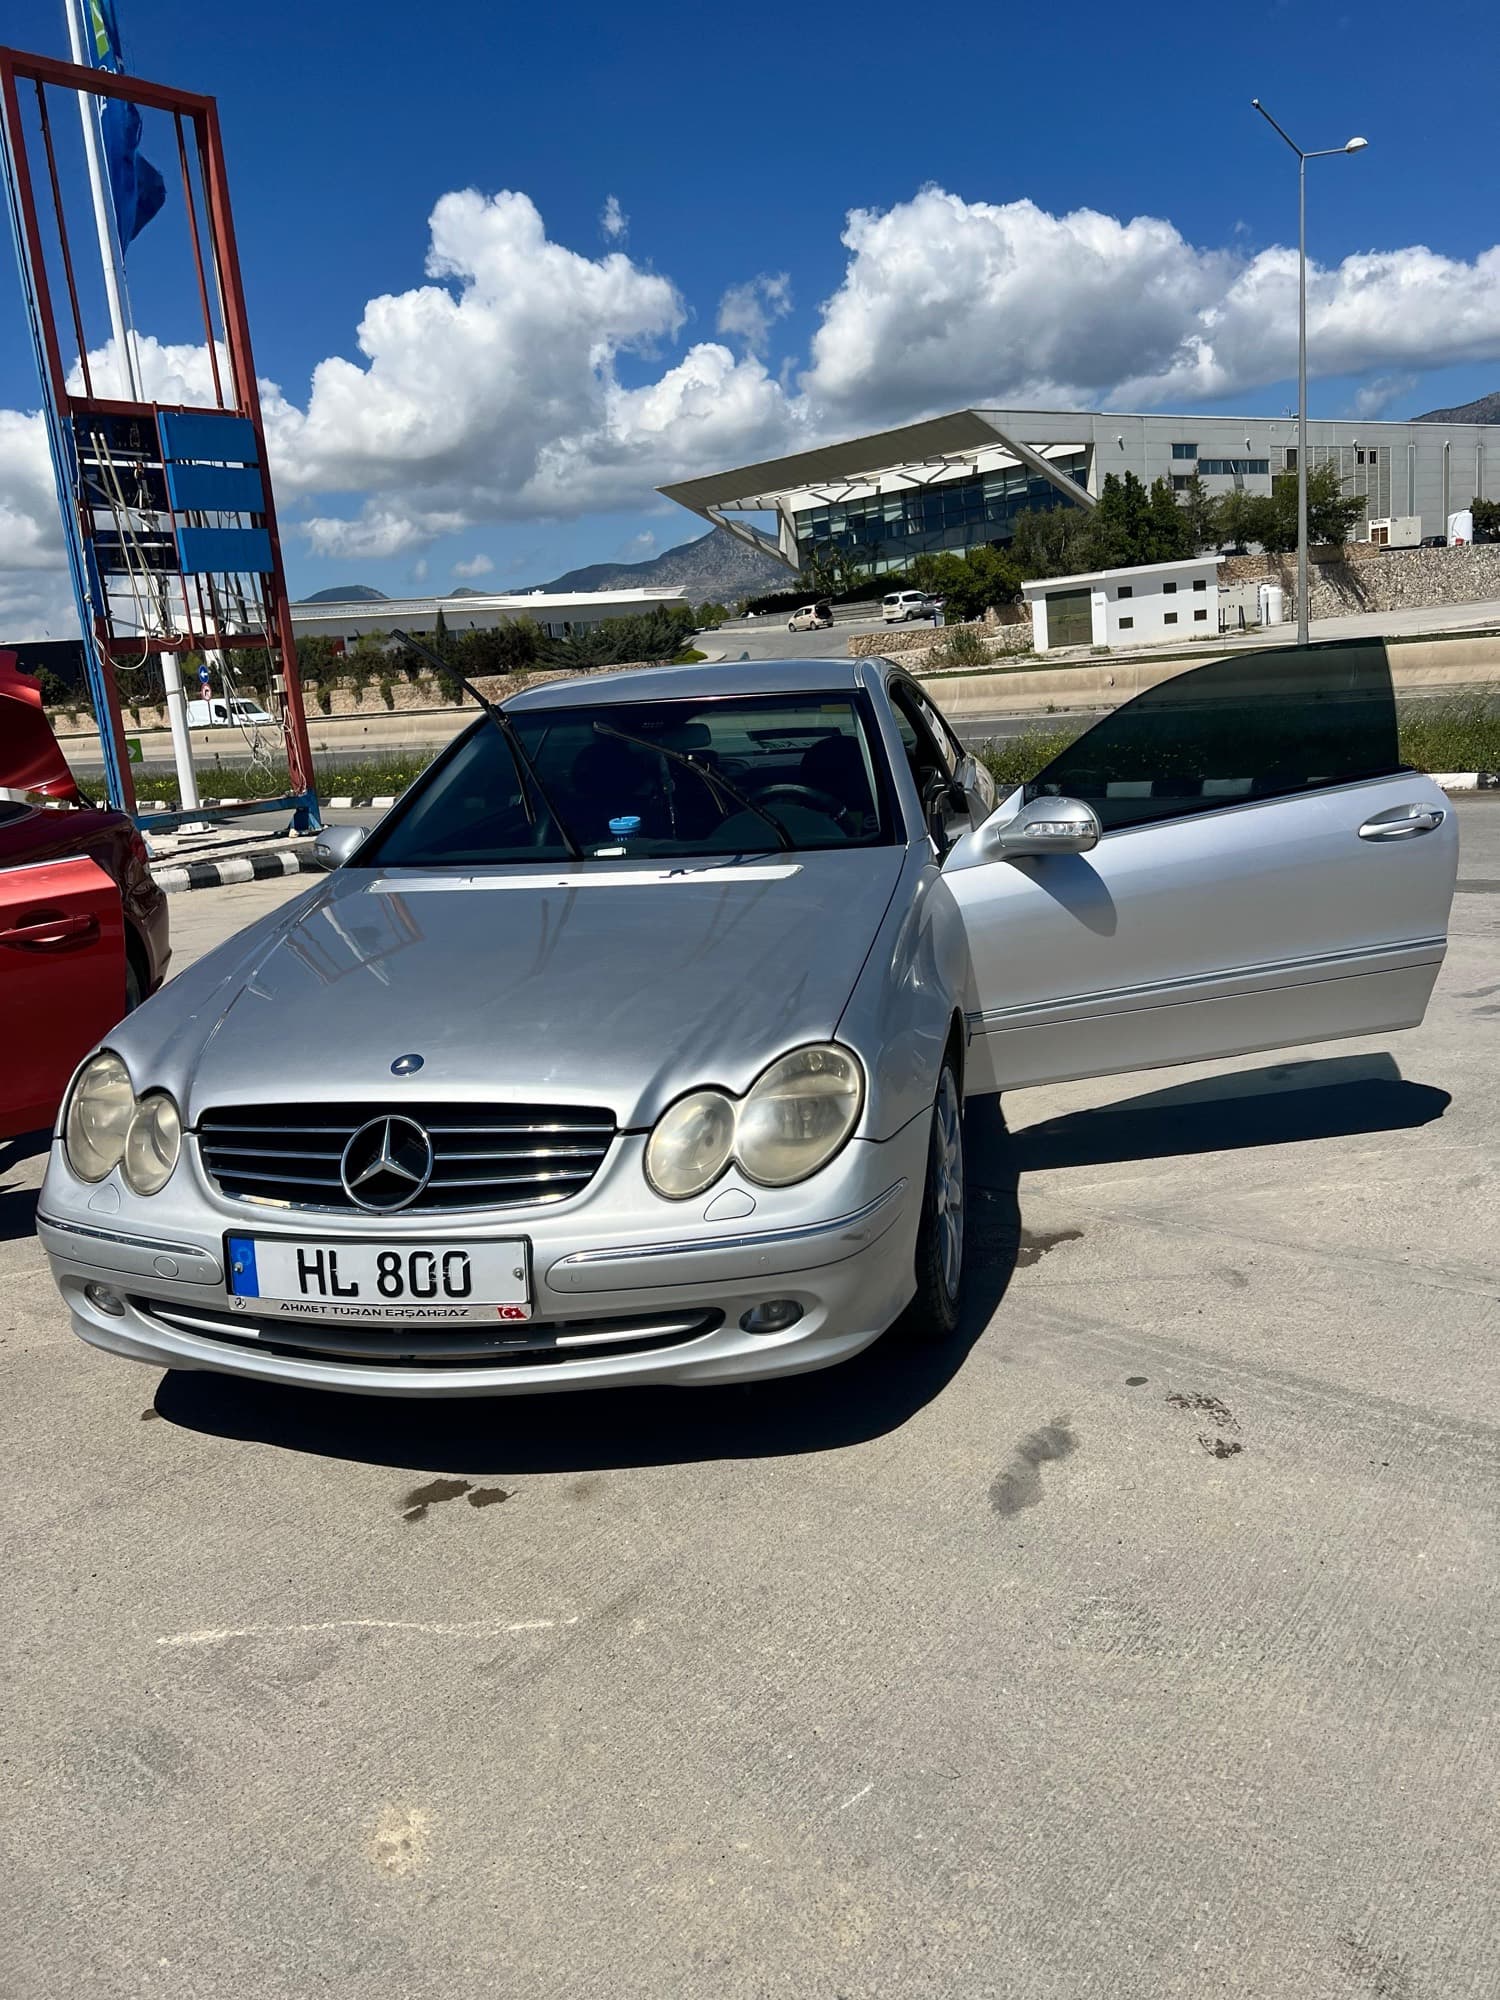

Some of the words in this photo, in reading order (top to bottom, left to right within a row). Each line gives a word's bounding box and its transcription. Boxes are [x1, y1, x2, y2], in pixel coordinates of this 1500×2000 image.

[297, 1248, 359, 1297] HL
[376, 1251, 472, 1298] 800
[280, 1303, 328, 1314] AHMET
[332, 1306, 382, 1317] TURAN
